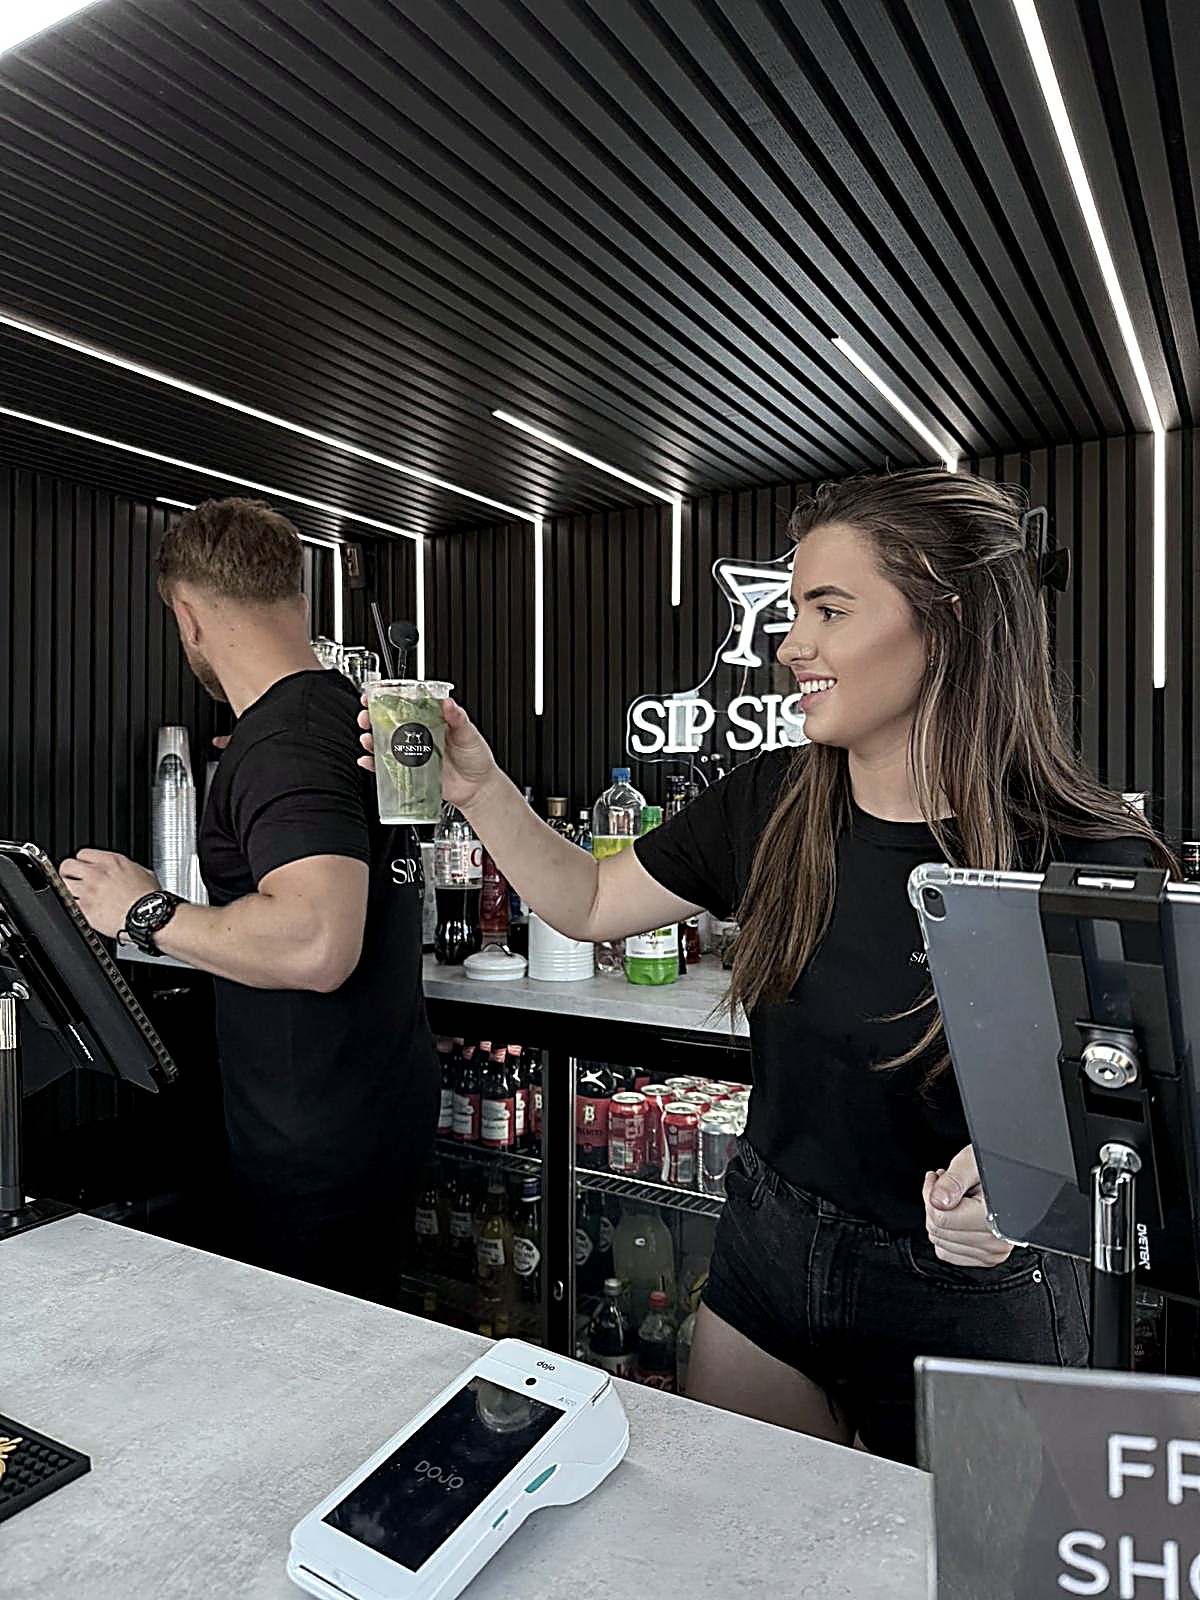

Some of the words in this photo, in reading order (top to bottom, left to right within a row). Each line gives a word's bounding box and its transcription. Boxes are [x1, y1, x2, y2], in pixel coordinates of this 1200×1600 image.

[631, 700, 715, 754] SIP
[536, 1360, 556, 1371] dojo
[414, 1460, 464, 1489] DOJO
[1057, 1530, 1200, 1600] SH
